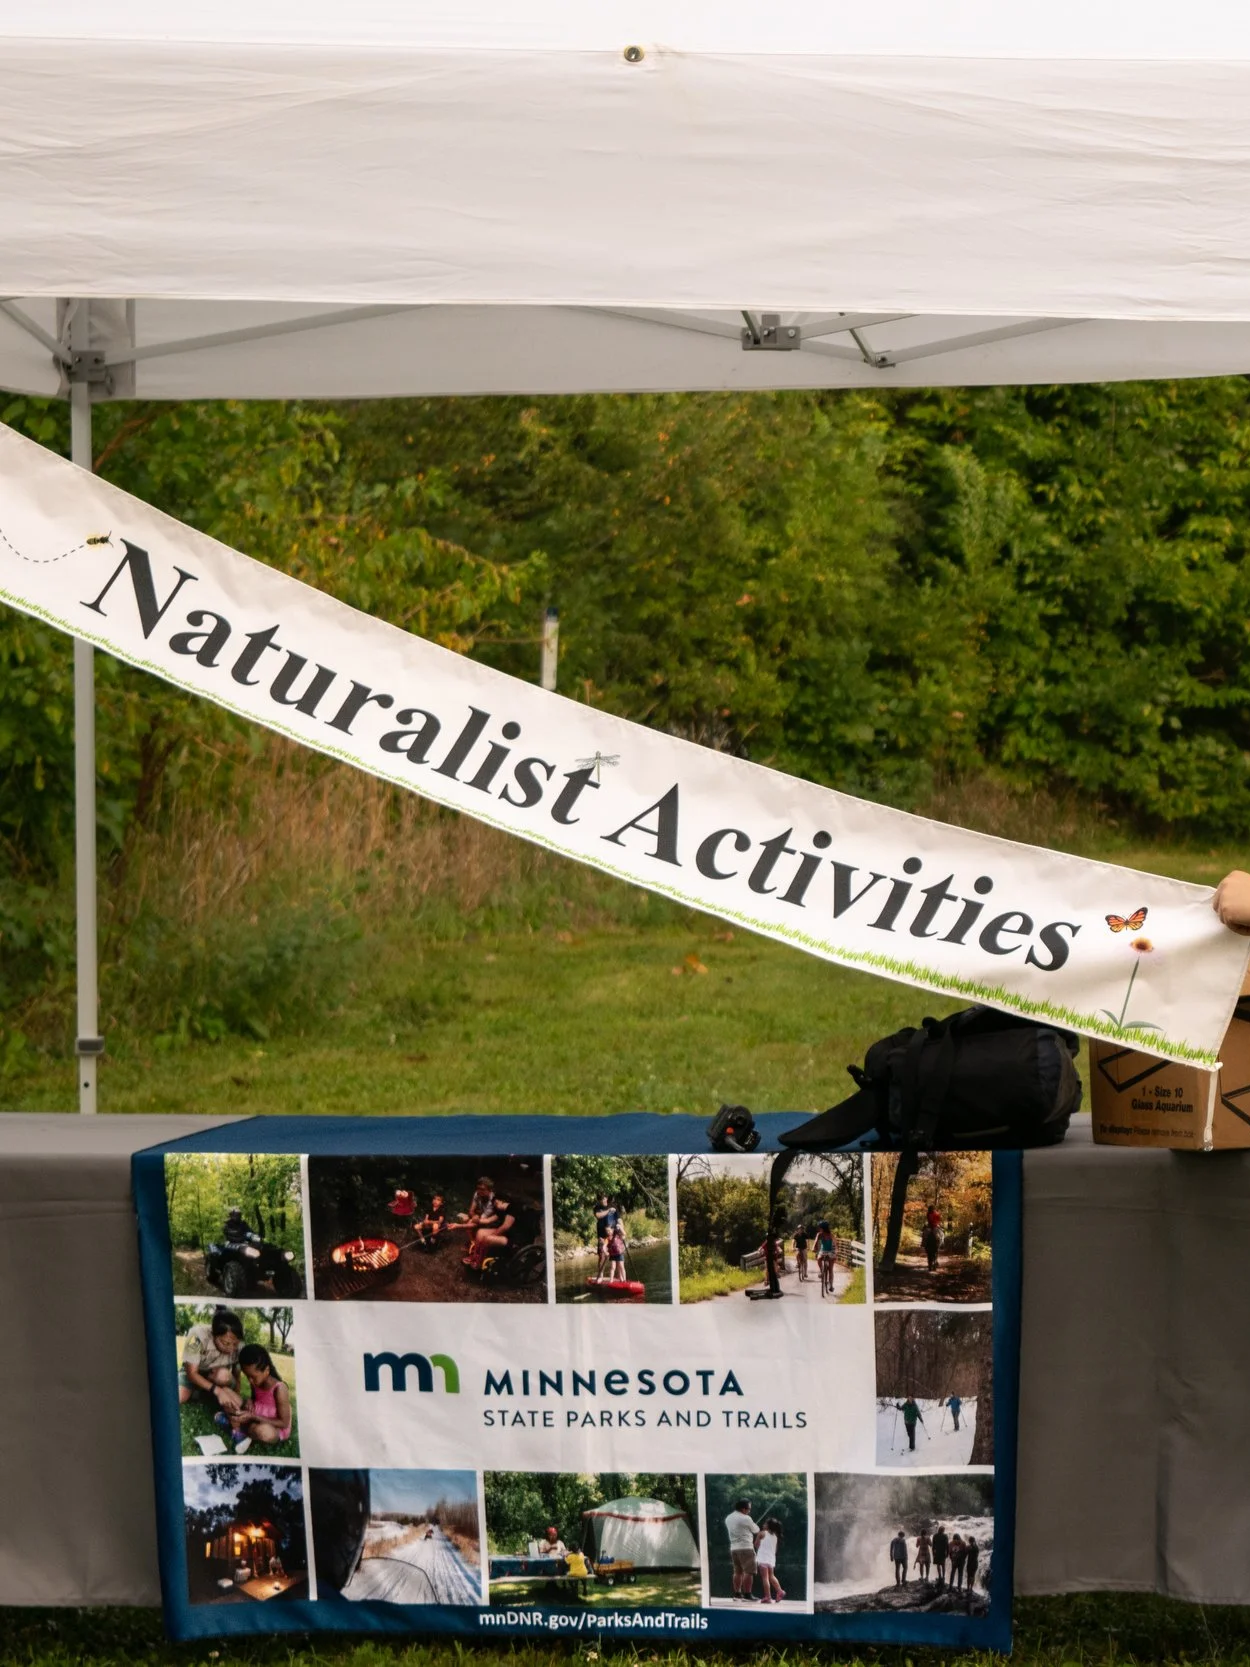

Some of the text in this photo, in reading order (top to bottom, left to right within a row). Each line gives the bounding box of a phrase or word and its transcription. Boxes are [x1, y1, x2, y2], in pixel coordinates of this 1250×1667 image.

[80, 538, 1081, 972] Naturalist Activities
[1142, 1086, 1147, 1097] 1
[1154, 1085, 1171, 1098] Size
[1174, 1087, 1184, 1098] 10
[1131, 1099, 1194, 1113] Glass Aquarium
[363, 1351, 460, 1394] mn
[484, 1410, 807, 1429] STATE PARKS AND TRAILS
[479, 1611, 709, 1630] mnDNR.gov/ParksAndTrails
